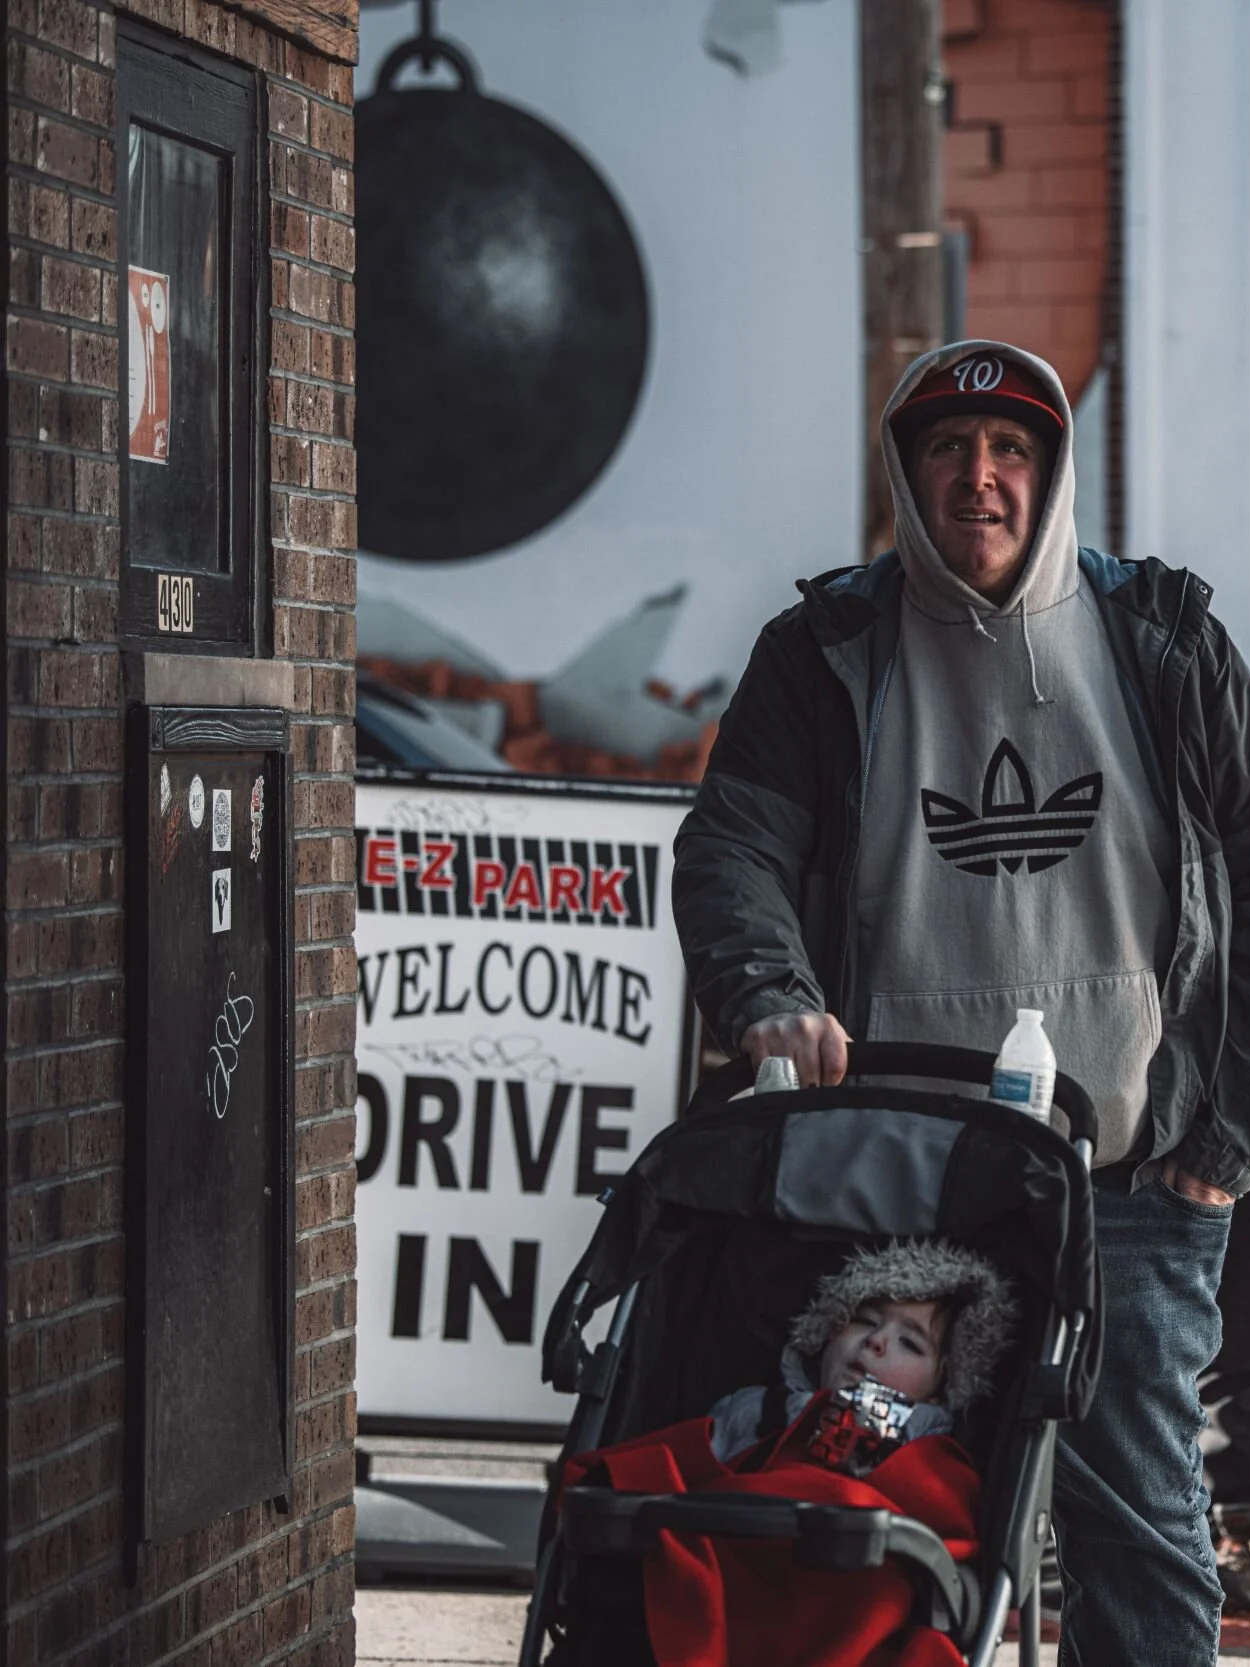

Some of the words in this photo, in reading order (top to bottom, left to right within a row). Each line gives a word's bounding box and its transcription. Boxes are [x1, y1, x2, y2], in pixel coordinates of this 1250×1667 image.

[159, 579, 192, 629] 430
[364, 838, 457, 888] E-Z
[472, 861, 629, 915] PARK
[390, 1232, 541, 1346] IN
